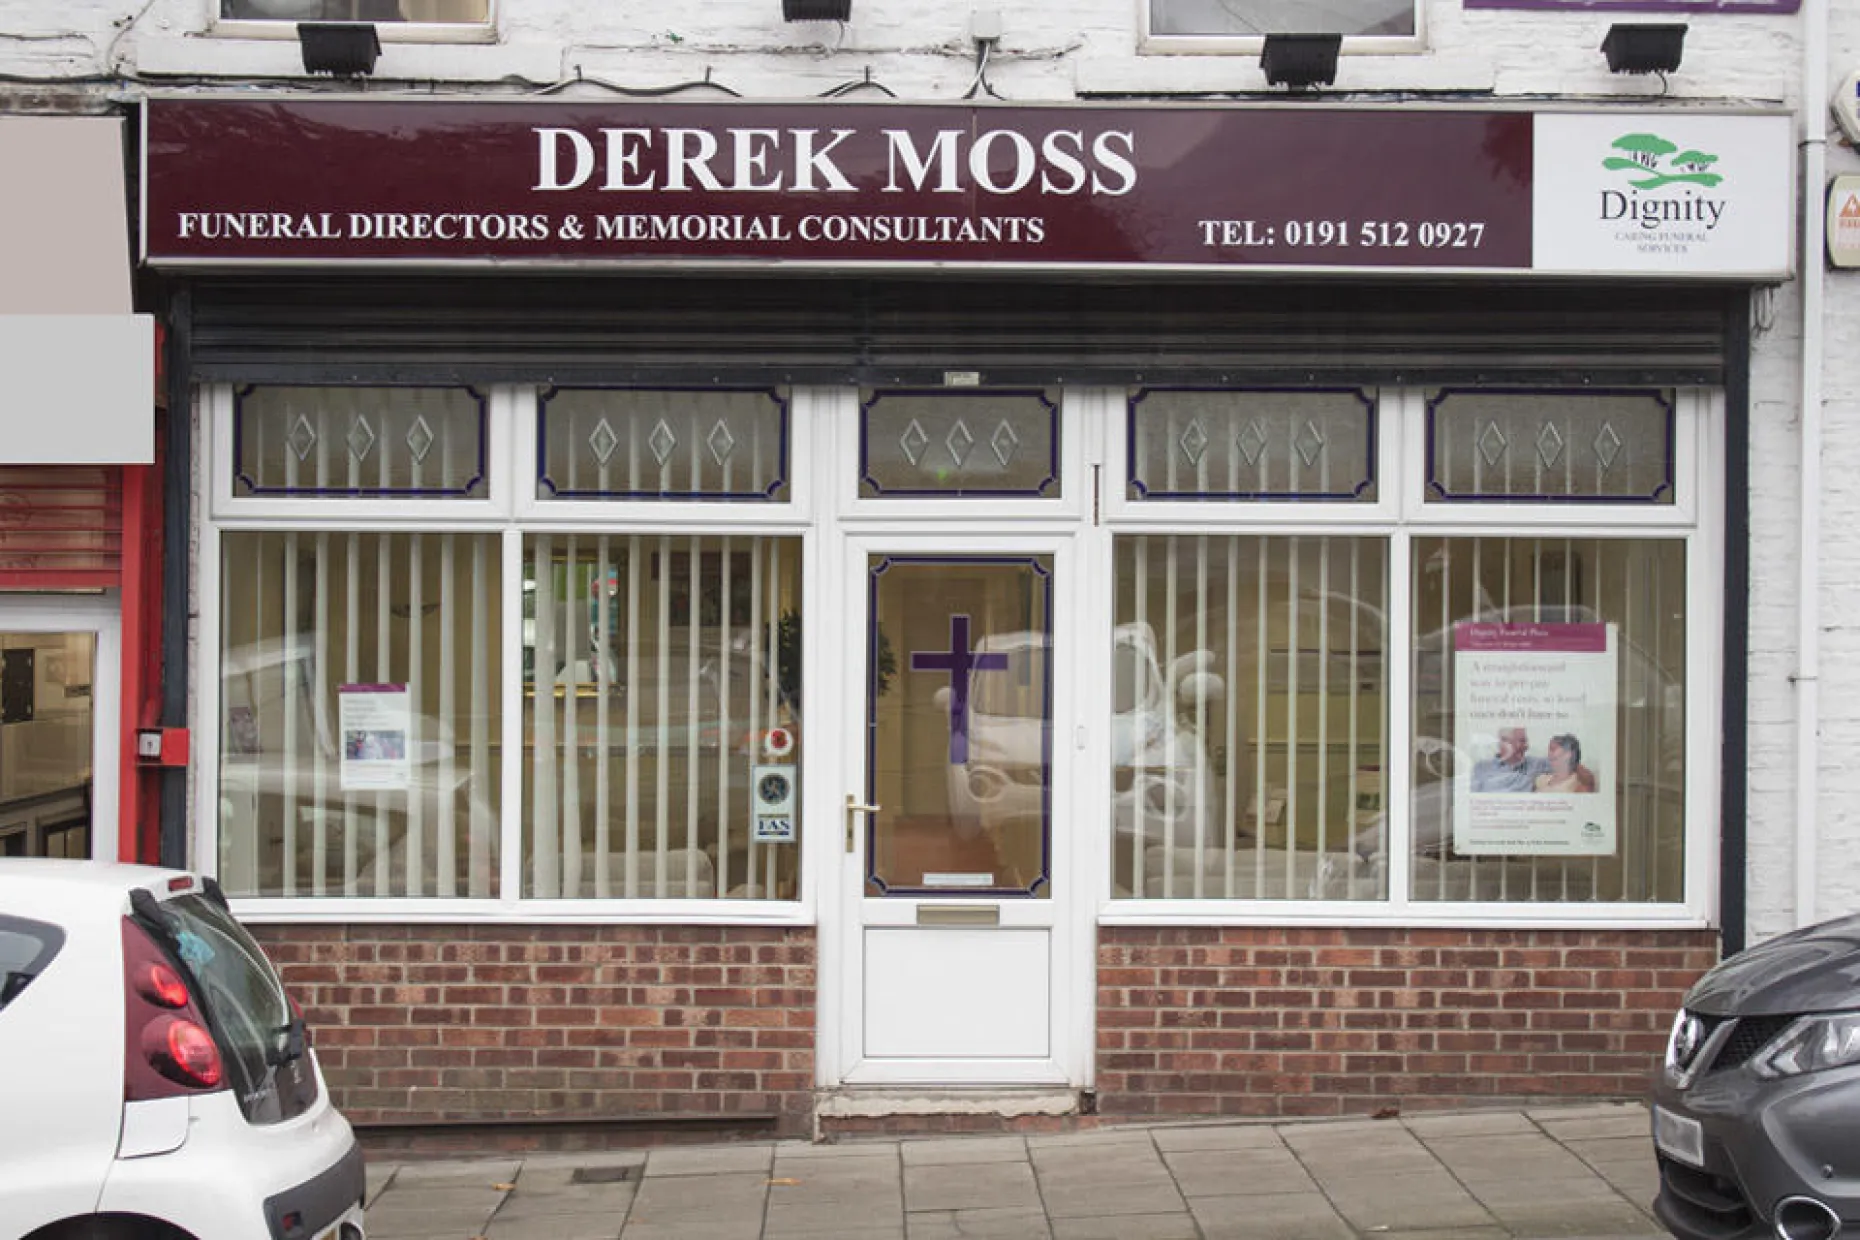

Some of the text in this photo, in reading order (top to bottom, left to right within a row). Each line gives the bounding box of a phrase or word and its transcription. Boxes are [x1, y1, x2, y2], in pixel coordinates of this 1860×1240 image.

[532, 127, 1138, 196] DEREK MOSS
[1600, 189, 1725, 230] Dignity
[177, 211, 1046, 244] FUNERAL DIRECTORS & MEMORIAL CONSULTANTS
[1198, 219, 1486, 248] TEL: 0191 512 0927
[1614, 230, 1708, 243] CARING FUNERAL
